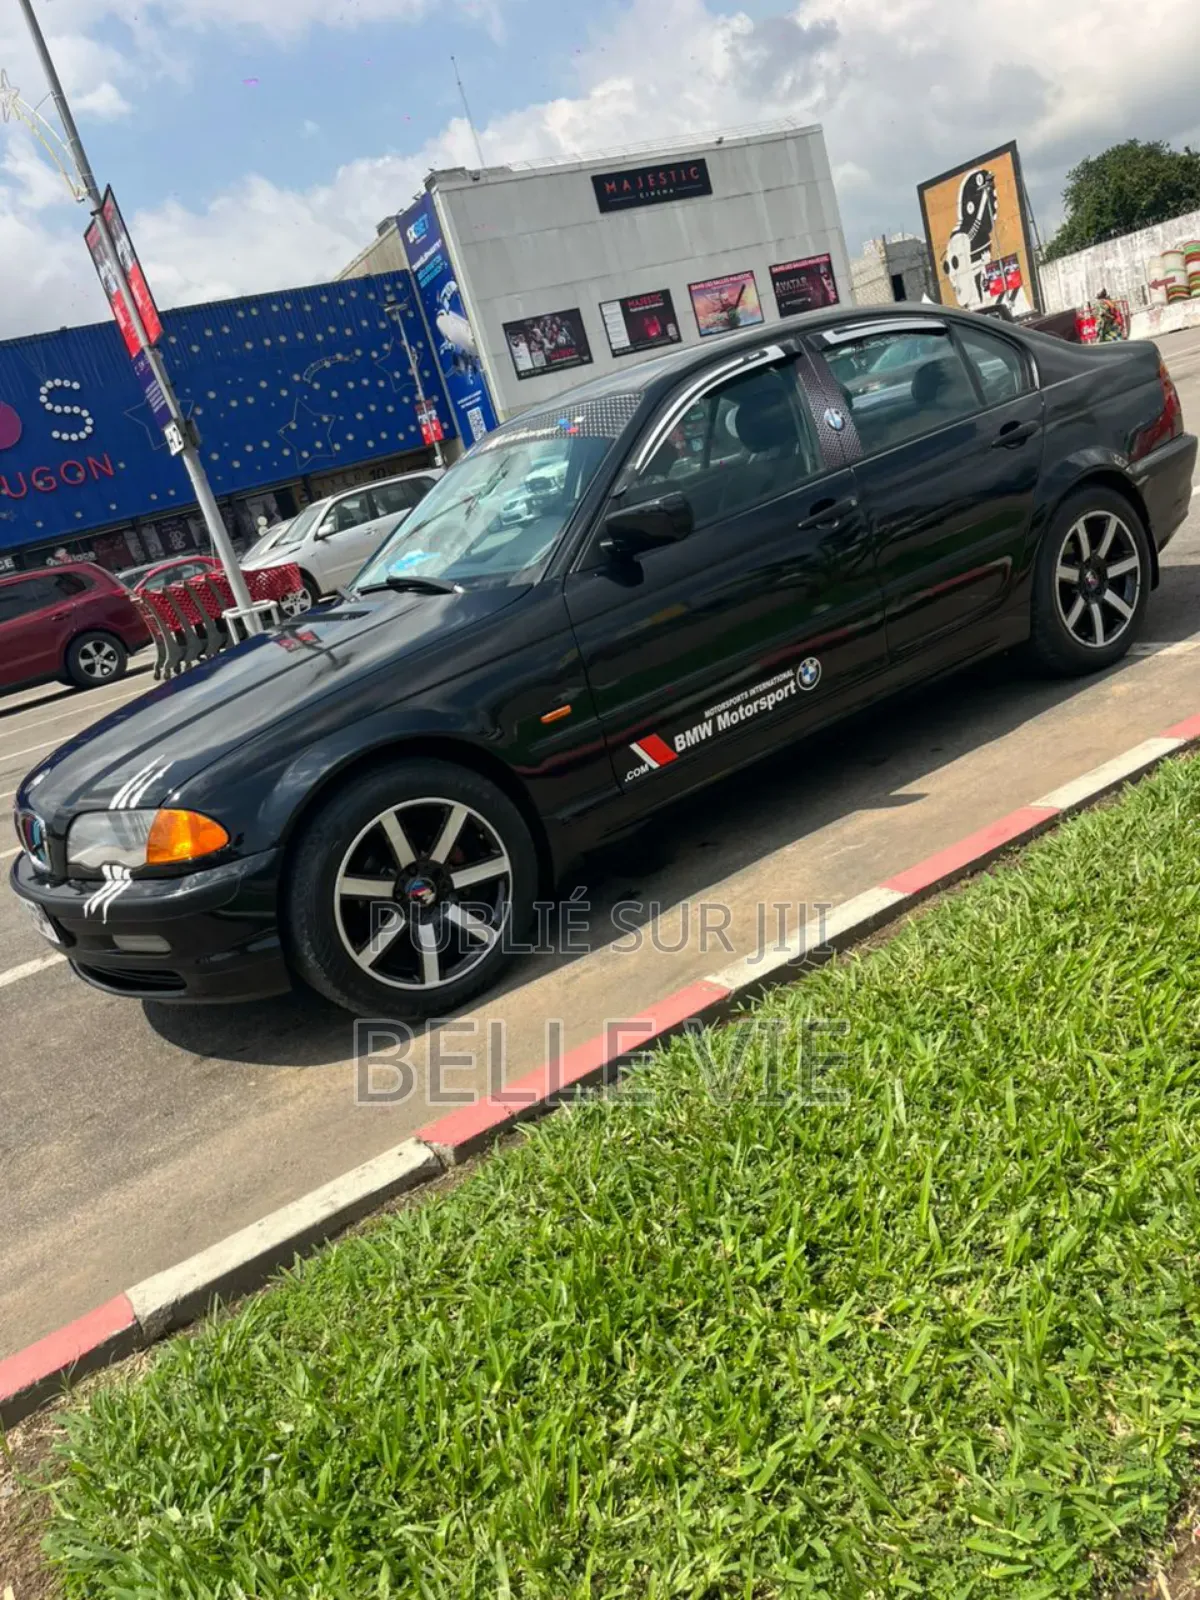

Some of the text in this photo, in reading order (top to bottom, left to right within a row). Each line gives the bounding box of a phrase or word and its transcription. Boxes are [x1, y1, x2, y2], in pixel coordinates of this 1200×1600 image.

[604, 166, 700, 194] MAJESTIC
[704, 668, 795, 719] MOTORSPORTS INTERNATIONAL
[674, 680, 797, 753] BMW Motorsport
[624, 763, 650, 783] .COM
